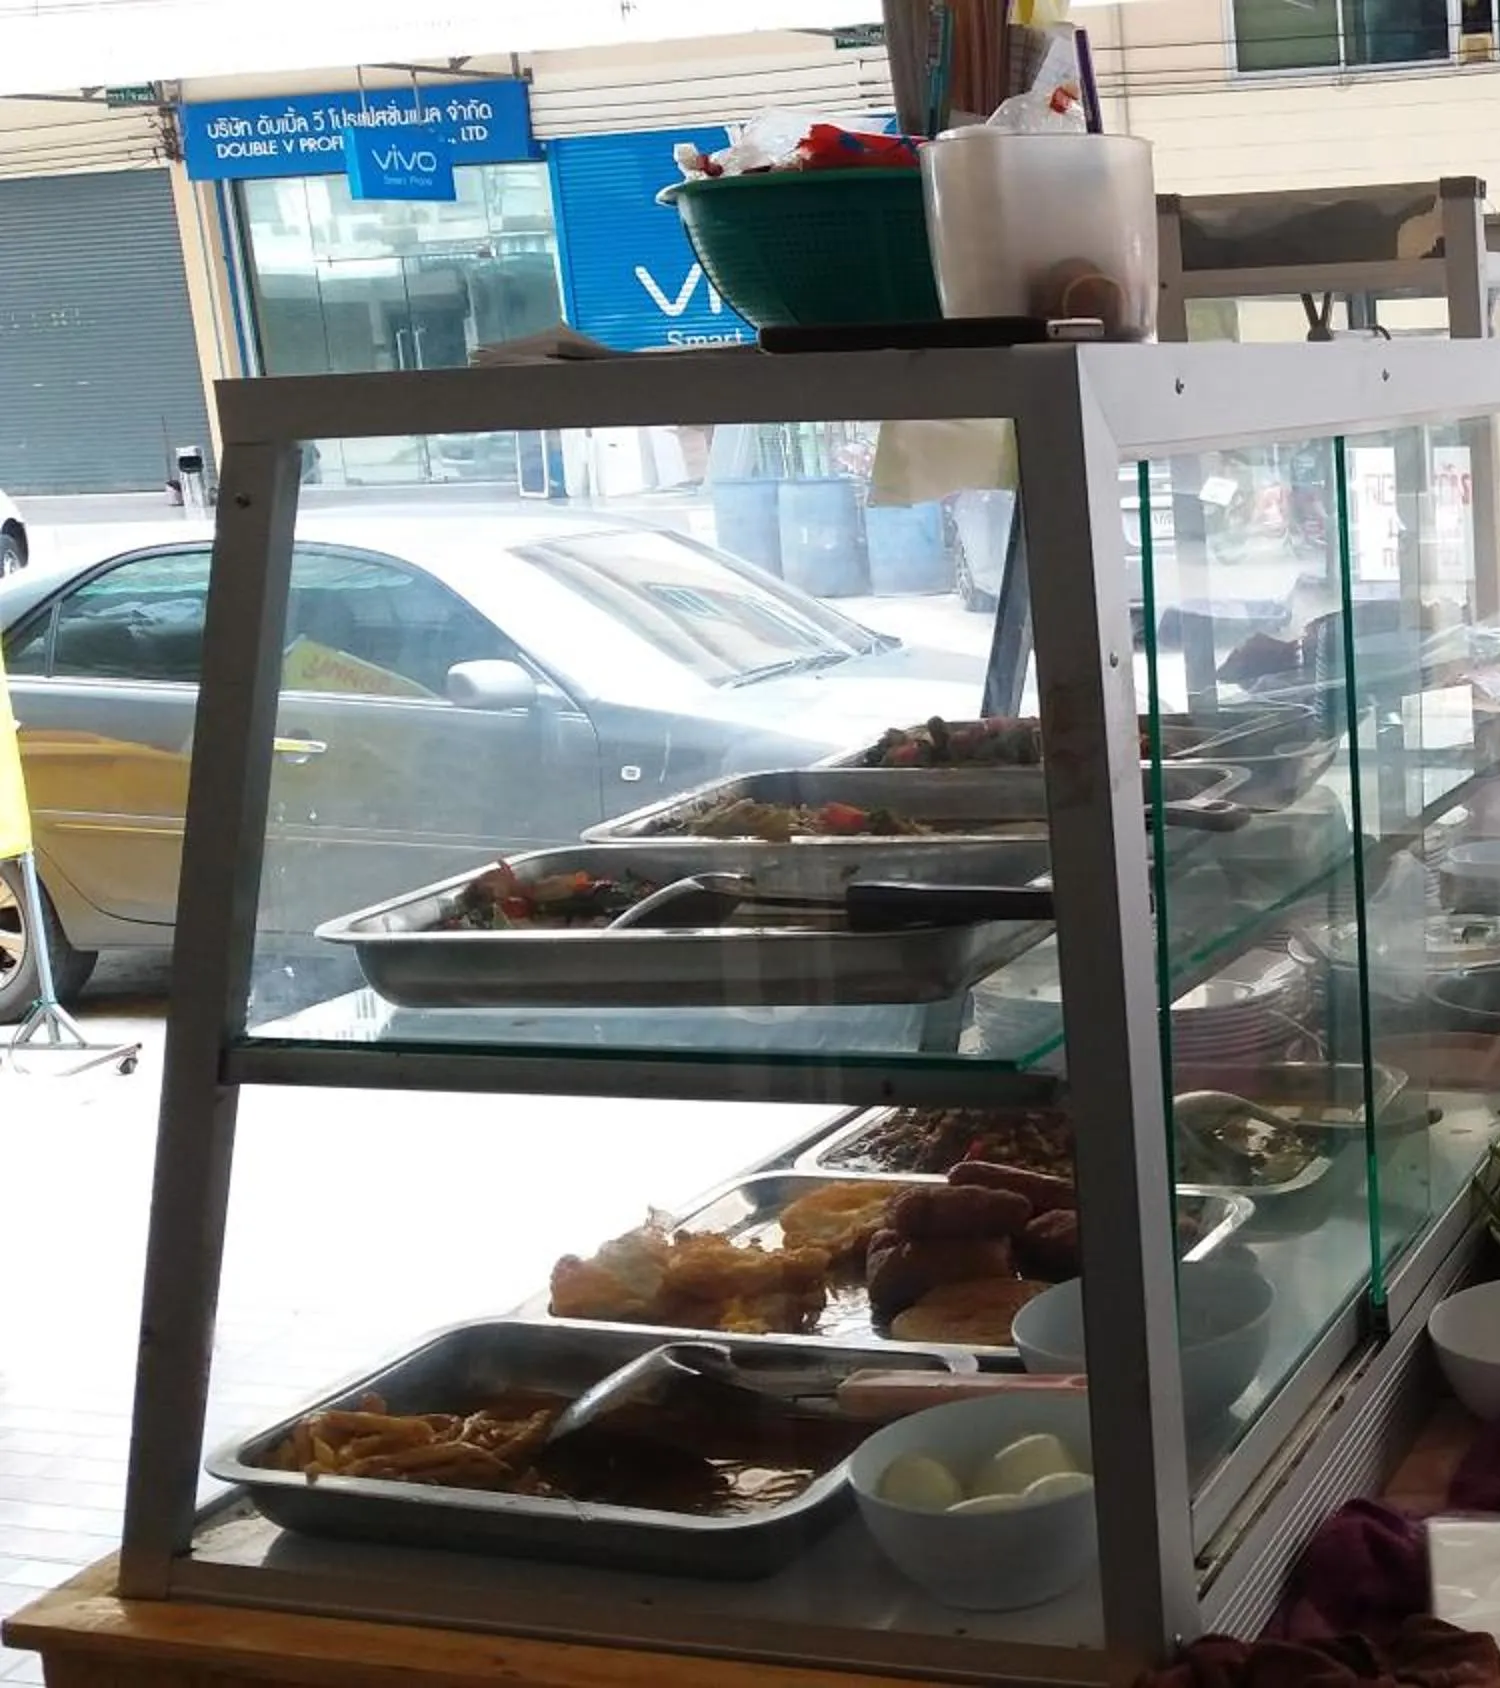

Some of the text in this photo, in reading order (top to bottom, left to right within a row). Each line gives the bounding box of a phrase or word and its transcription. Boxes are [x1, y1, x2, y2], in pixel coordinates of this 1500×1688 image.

[206, 116, 252, 139] บริษัท
[312, 109, 325, 131] วี
[446, 99, 493, 122] จำกัด
[215, 139, 279, 159] DOUBLE
[282, 139, 295, 154] V
[460, 125, 489, 141] LTD
[371, 143, 438, 172] vivo
[667, 327, 744, 346] Smart
